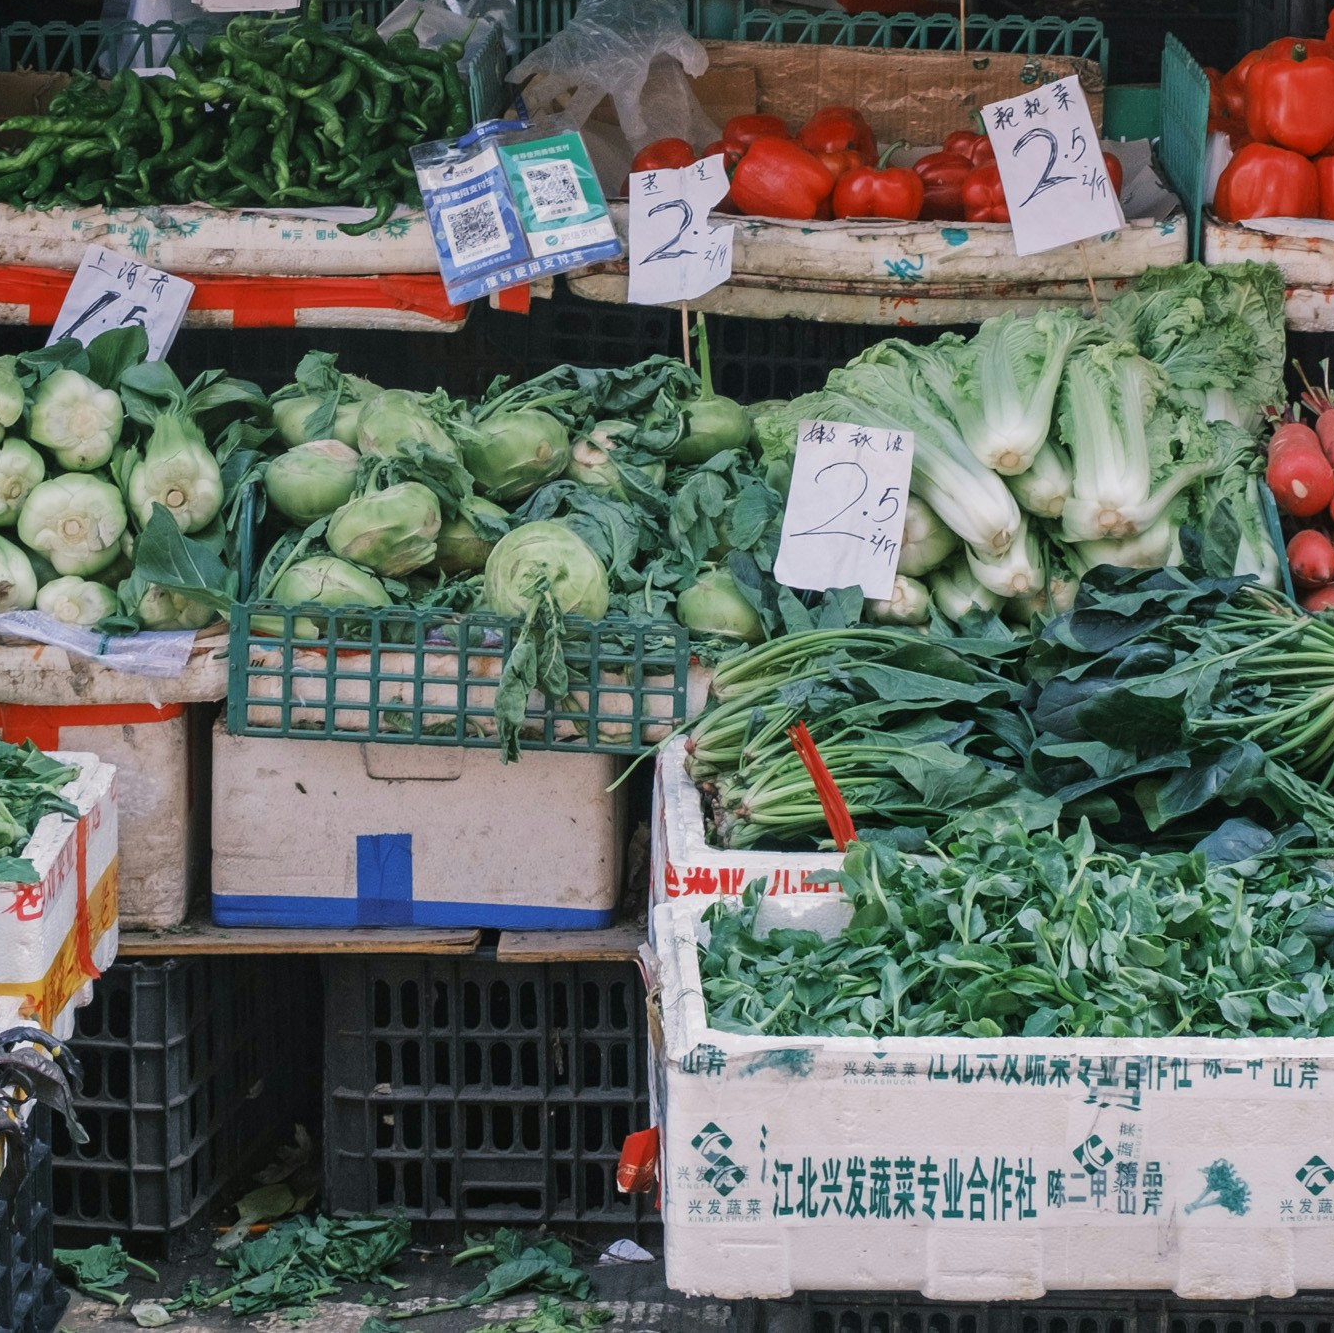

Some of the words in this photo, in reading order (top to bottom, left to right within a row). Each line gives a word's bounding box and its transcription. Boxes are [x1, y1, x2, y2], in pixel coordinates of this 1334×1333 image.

[1012, 125, 1087, 209] 2.5
[485, 250, 585, 289] 推荐使用支付宝
[788, 460, 900, 541] 2.5
[842, 1060, 917, 1078] 兴发蔬菜
[688, 1198, 763, 1217] 兴发蔬菜
[772, 1154, 1038, 1221] 江北兴发蔬菜专业合作社
[1047, 1168, 1108, 1210] 陈二甲
